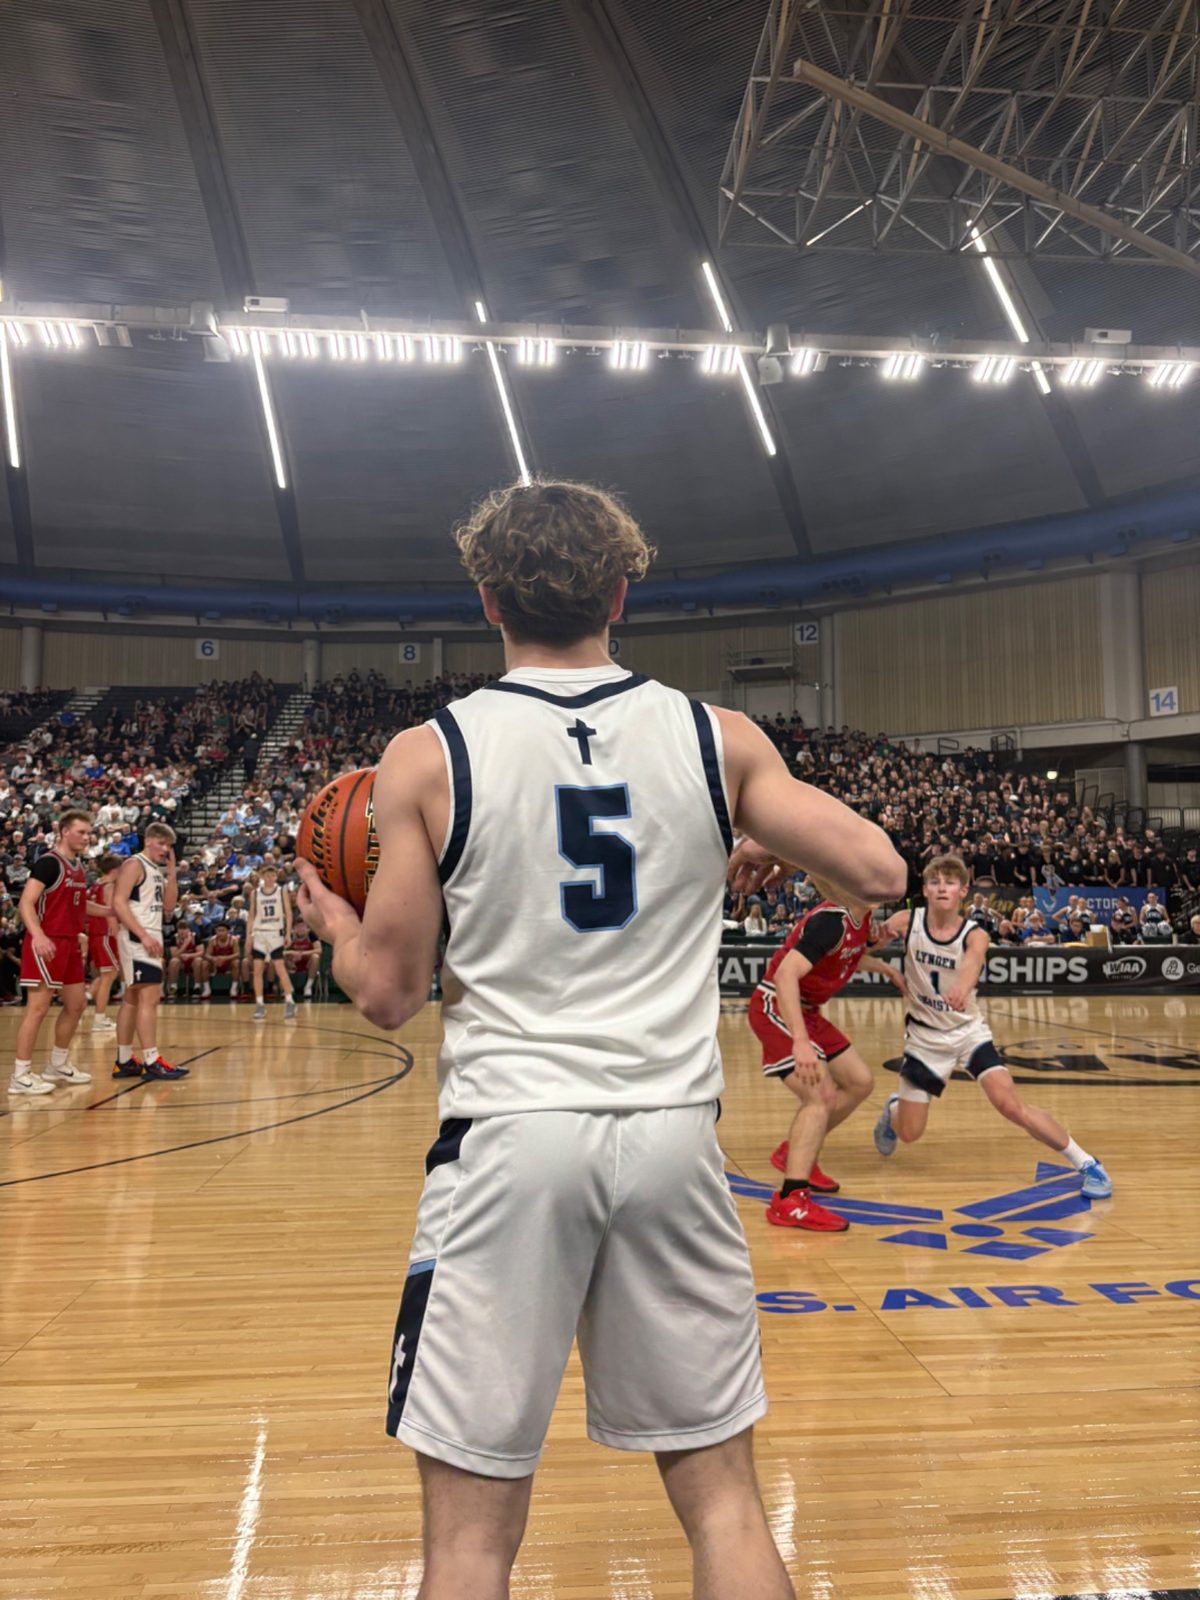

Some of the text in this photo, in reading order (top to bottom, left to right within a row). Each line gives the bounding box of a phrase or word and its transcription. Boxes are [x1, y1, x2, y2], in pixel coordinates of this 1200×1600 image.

[796, 624, 817, 641] 12
[201, 640, 214, 656] 6
[403, 645, 416, 661] 8
[1151, 691, 1176, 712] 14
[554, 782, 638, 934] 5
[881, 1285, 1080, 1311] AIR
